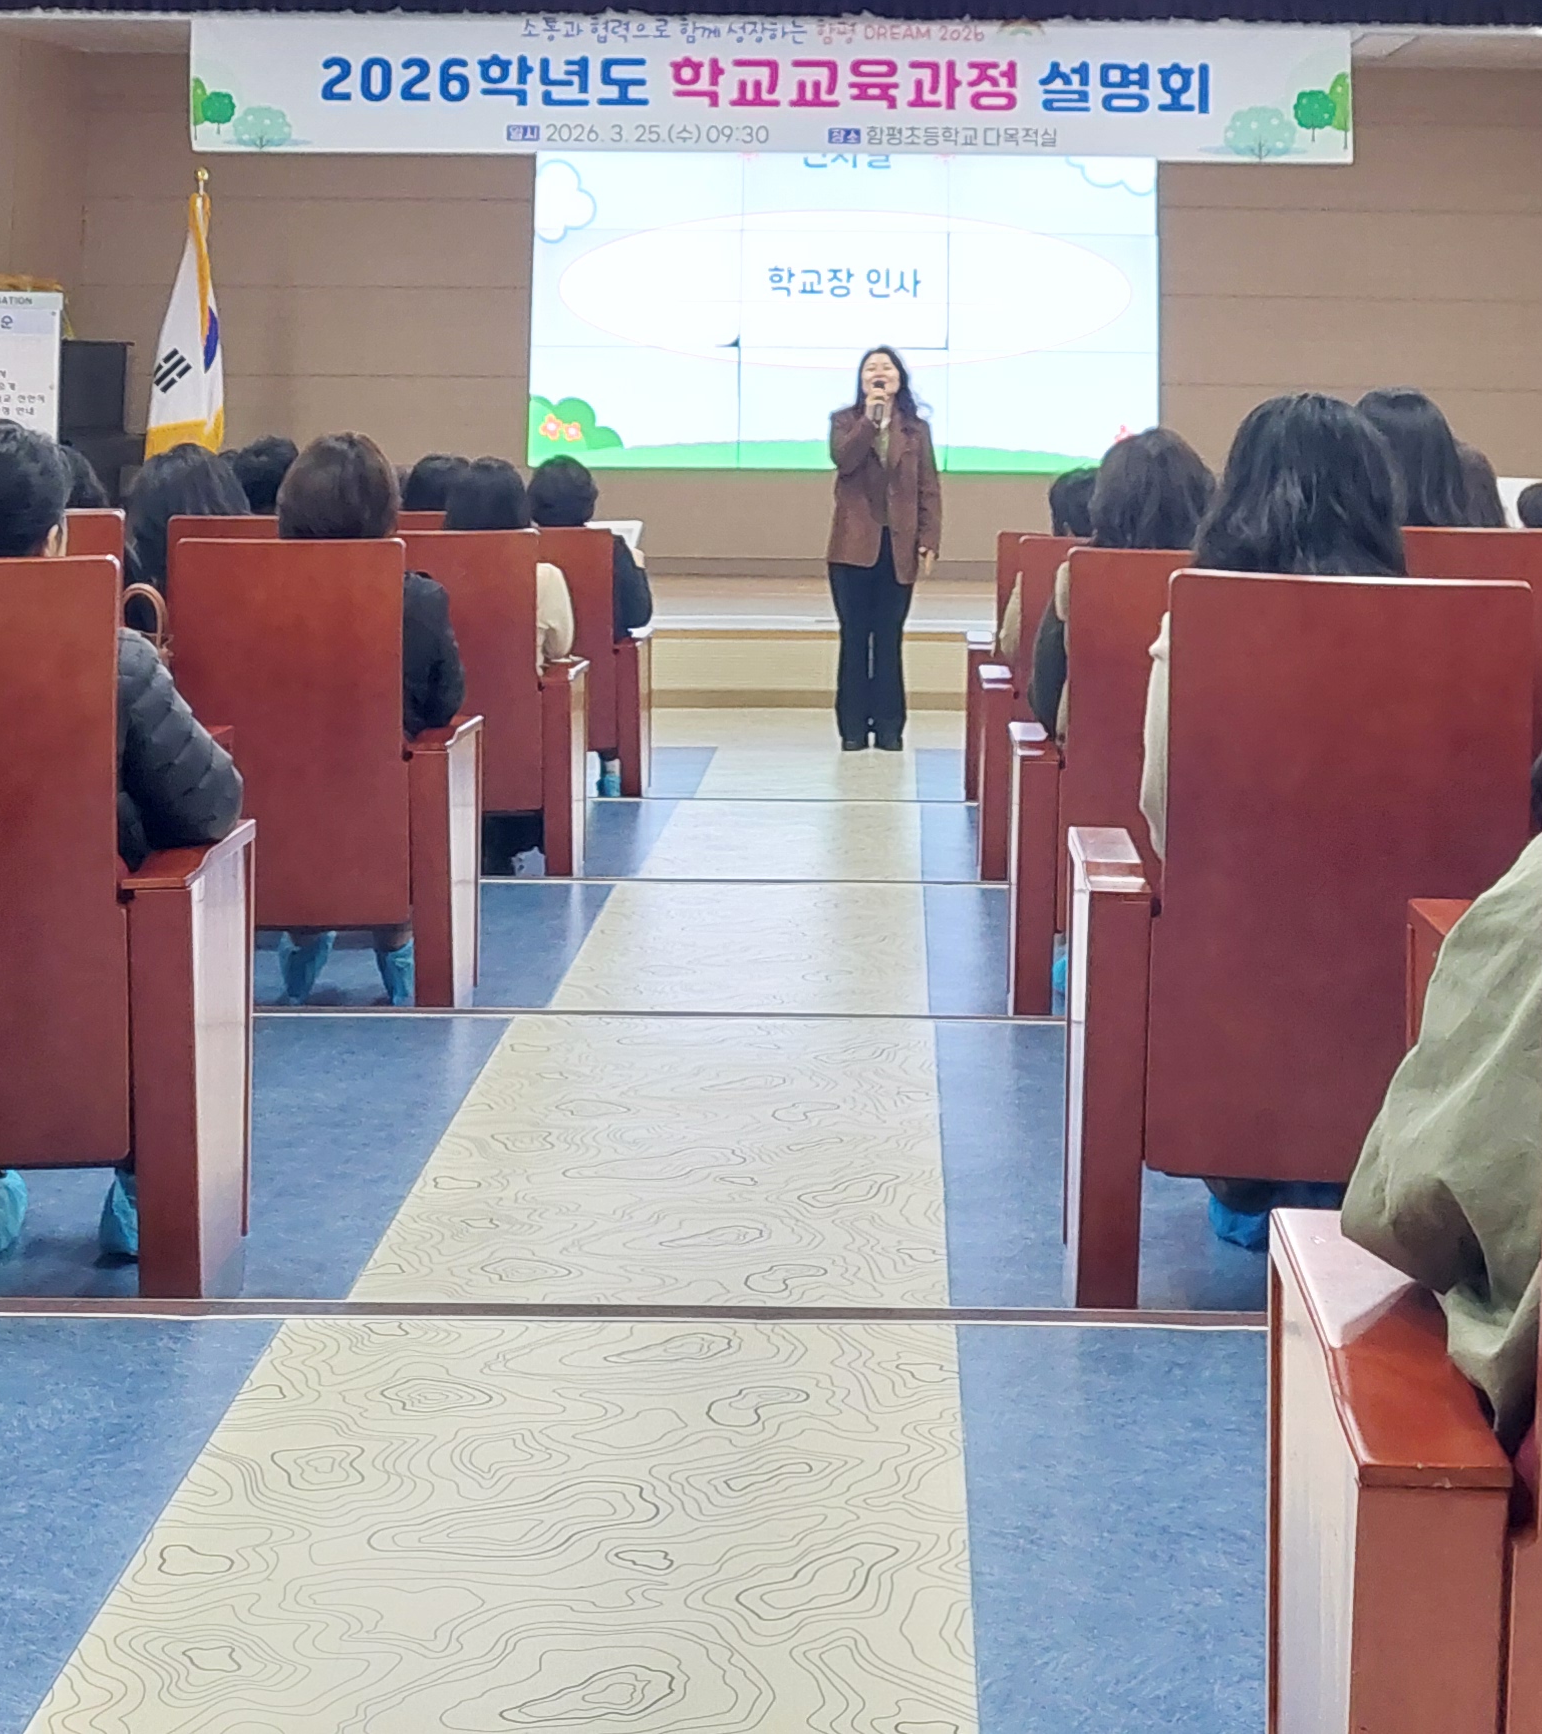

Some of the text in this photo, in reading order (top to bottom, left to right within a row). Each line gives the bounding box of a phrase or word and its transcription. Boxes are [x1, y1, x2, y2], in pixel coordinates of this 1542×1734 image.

[521, 17, 986, 45] 소통과 협력으로 함께 성장하는 함평 DREAM 2026
[321, 54, 1210, 114] 2026학년도 학교교육과정 설명회
[829, 126, 1057, 147] 장소 함평초등학교 다목적실
[768, 265, 921, 298] 학교장 인사
